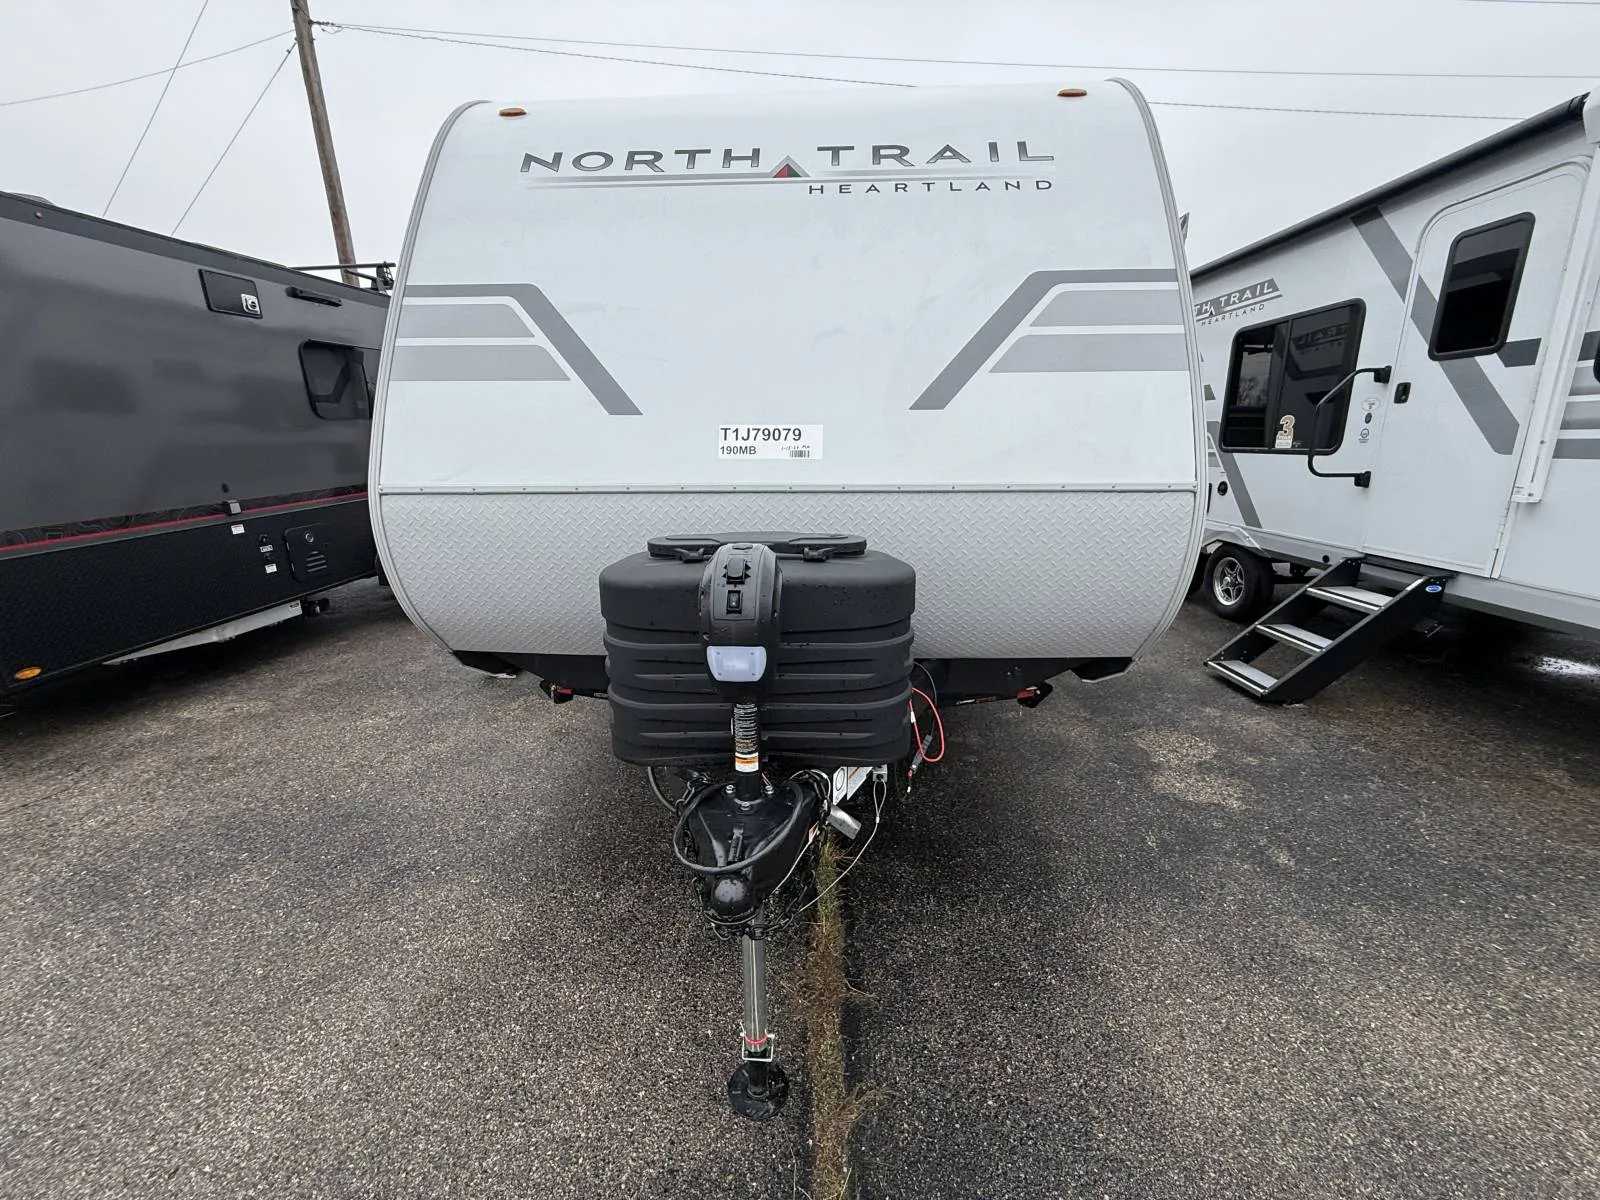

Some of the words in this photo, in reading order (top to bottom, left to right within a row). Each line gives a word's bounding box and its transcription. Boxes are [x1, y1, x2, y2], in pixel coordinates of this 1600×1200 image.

[519, 147, 761, 173] NORTH
[816, 140, 1055, 167] TRAIL
[808, 179, 1053, 195] HEARTLAND
[1219, 282, 1273, 307] TRAIL
[1201, 303, 1265, 326] HEARTLAND
[720, 427, 802, 441] T1J79079
[720, 445, 757, 455] 190MB
